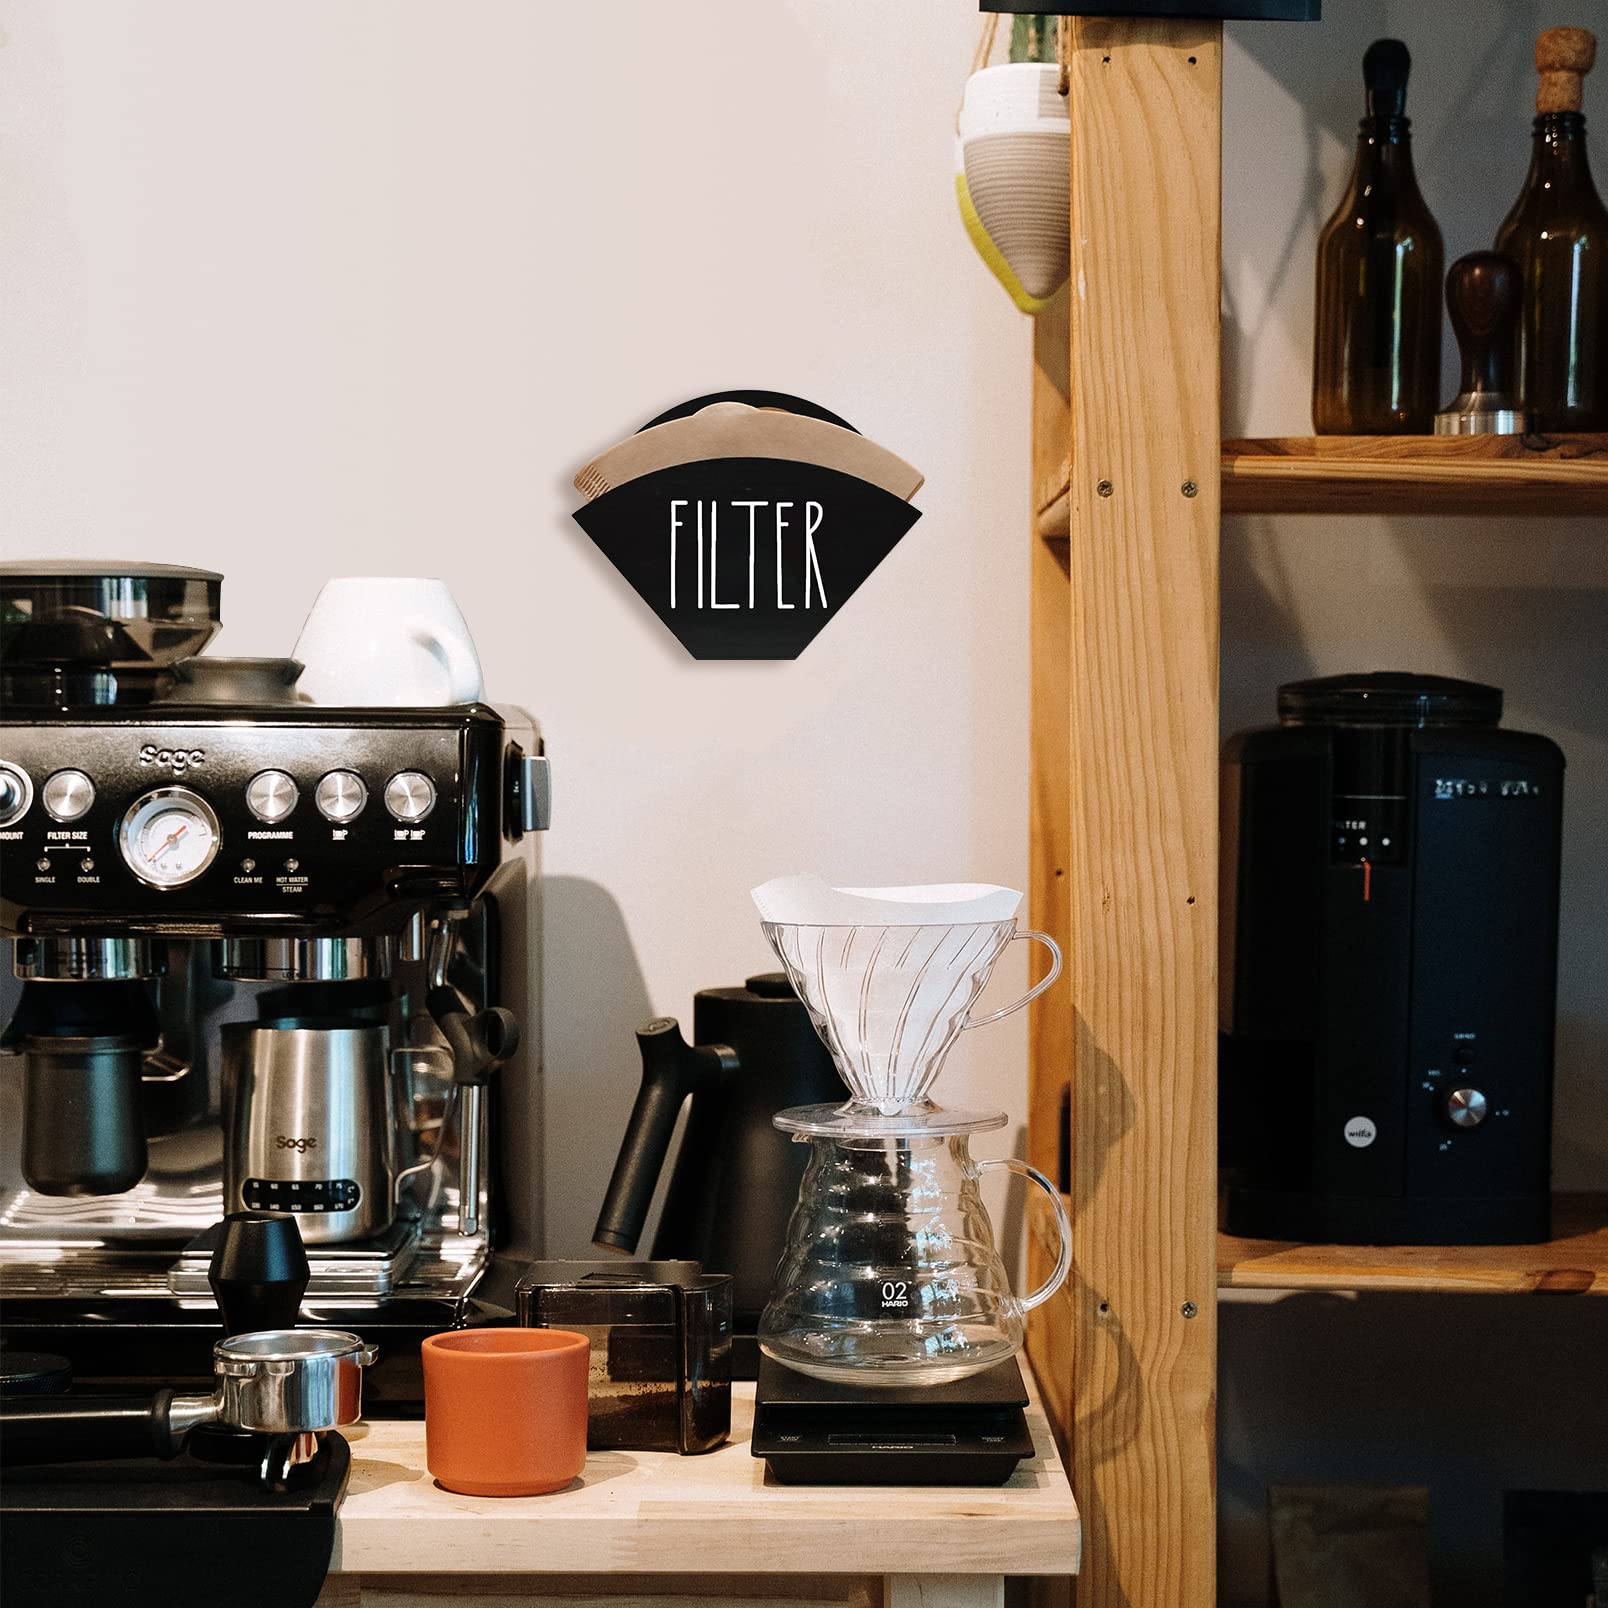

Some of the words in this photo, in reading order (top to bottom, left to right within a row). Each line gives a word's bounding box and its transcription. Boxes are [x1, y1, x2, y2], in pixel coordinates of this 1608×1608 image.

[670, 500, 828, 609] FILTER
[139, 744, 206, 776] Sage
[47, 831, 71, 840] FILTER
[72, 831, 88, 840] SIZE
[248, 831, 294, 840] PROGRAMME
[35, 876, 56, 884] SINGLE
[77, 876, 100, 884] DOUBLE
[233, 876, 253, 884] CLEAN
[253, 876, 263, 884] ME
[282, 886, 302, 894] STEAM
[276, 1135, 317, 1154] Sage
[882, 1281, 908, 1300] 02
[881, 1300, 909, 1308] HARIO
